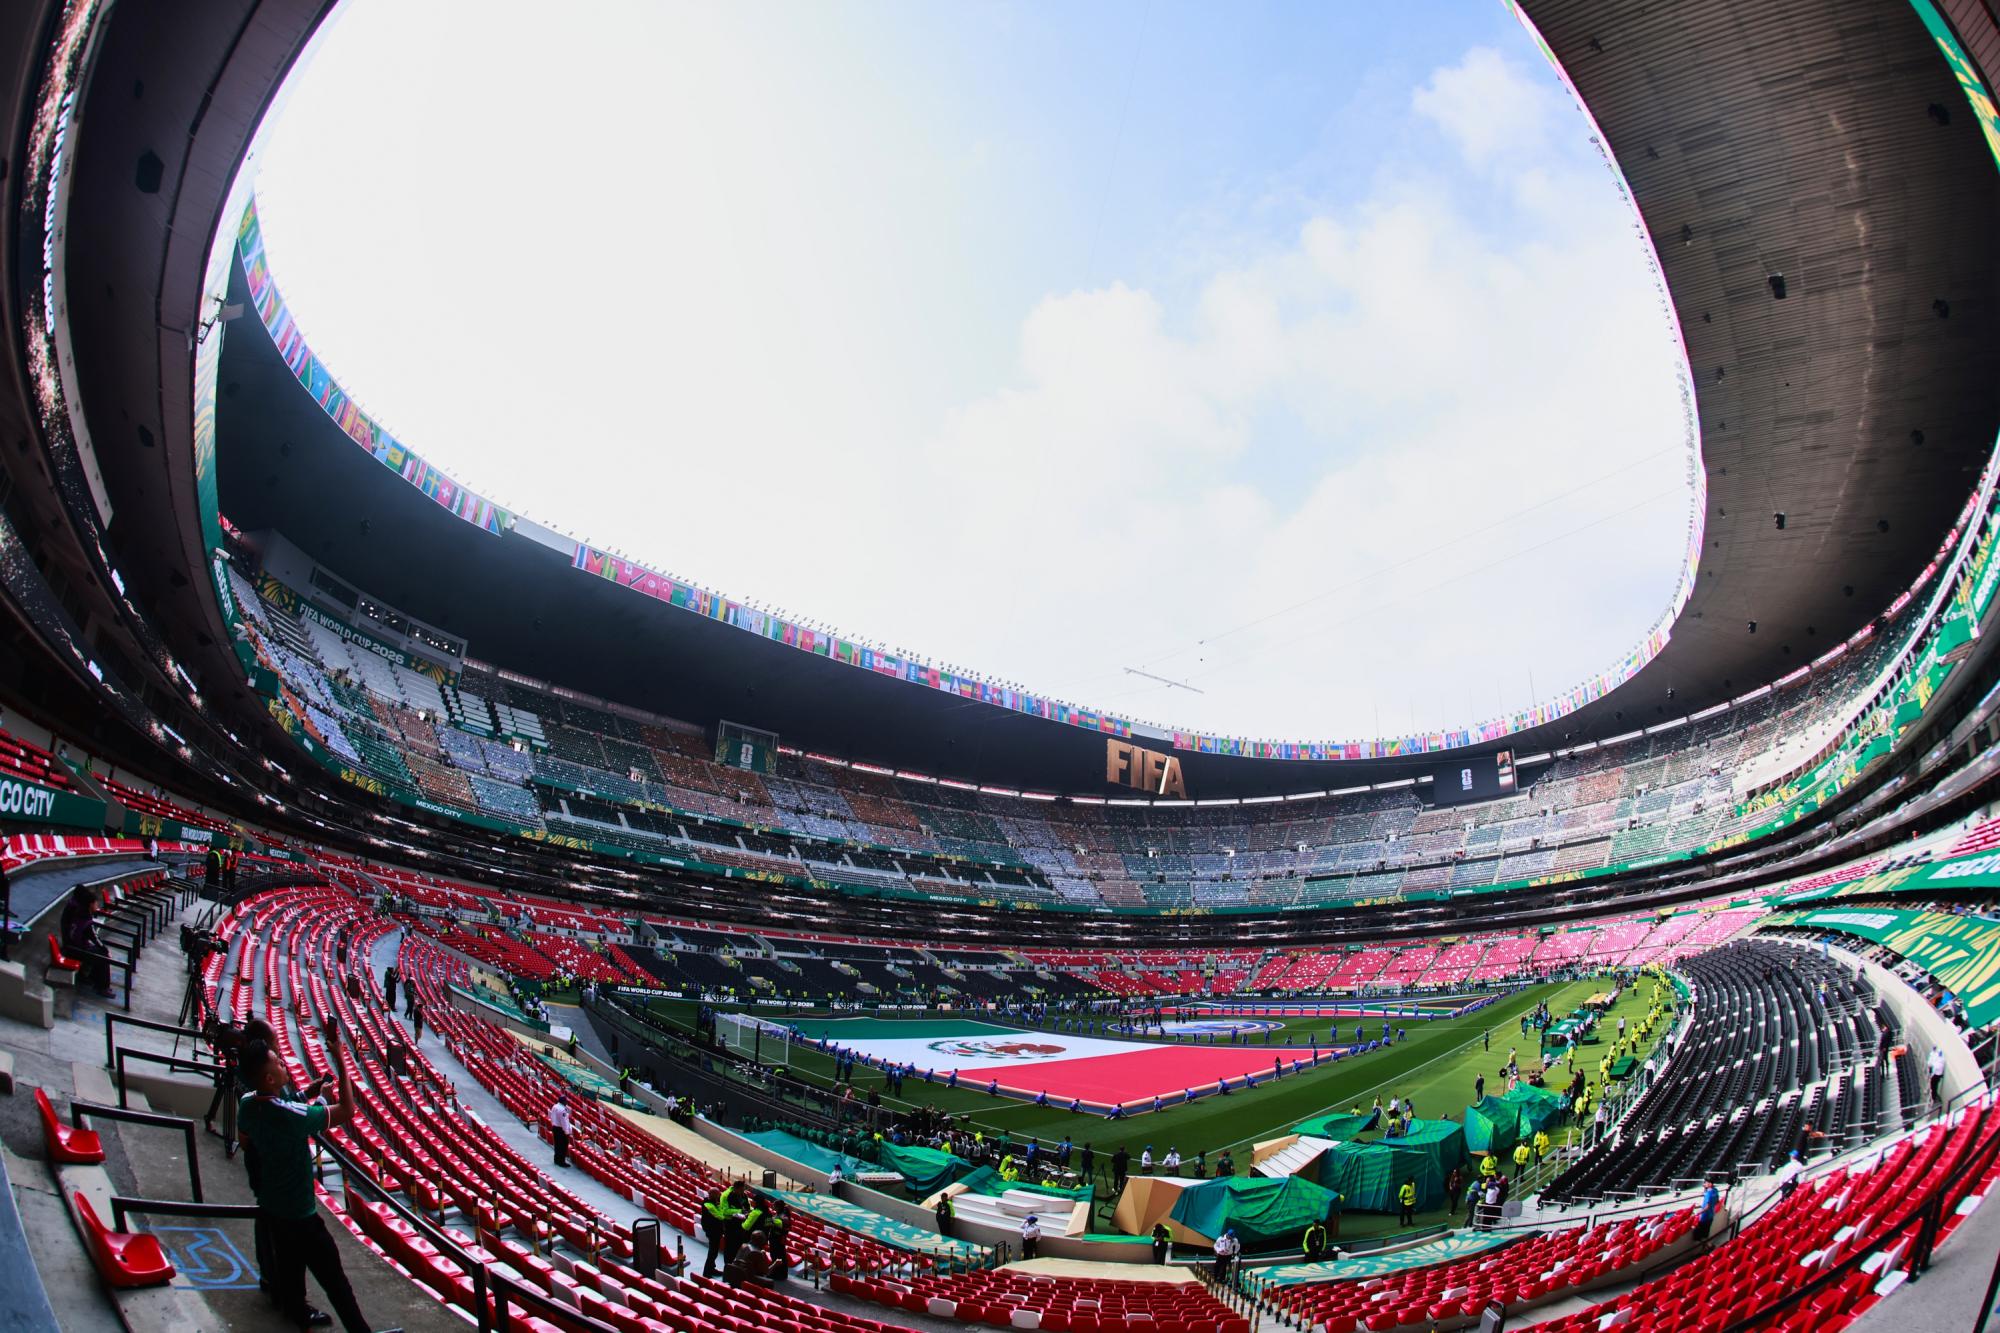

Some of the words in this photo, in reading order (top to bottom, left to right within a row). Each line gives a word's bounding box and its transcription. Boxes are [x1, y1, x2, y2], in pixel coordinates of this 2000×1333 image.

[300, 603, 318, 622] FIFA
[320, 614, 352, 639] WORLD
[352, 634, 372, 649] CUP
[372, 643, 405, 664] 2026
[1106, 738, 1187, 799] FIFA
[23, 786, 55, 816] CITY
[416, 800, 443, 813] MEXICO
[444, 808, 462, 819] CITY
